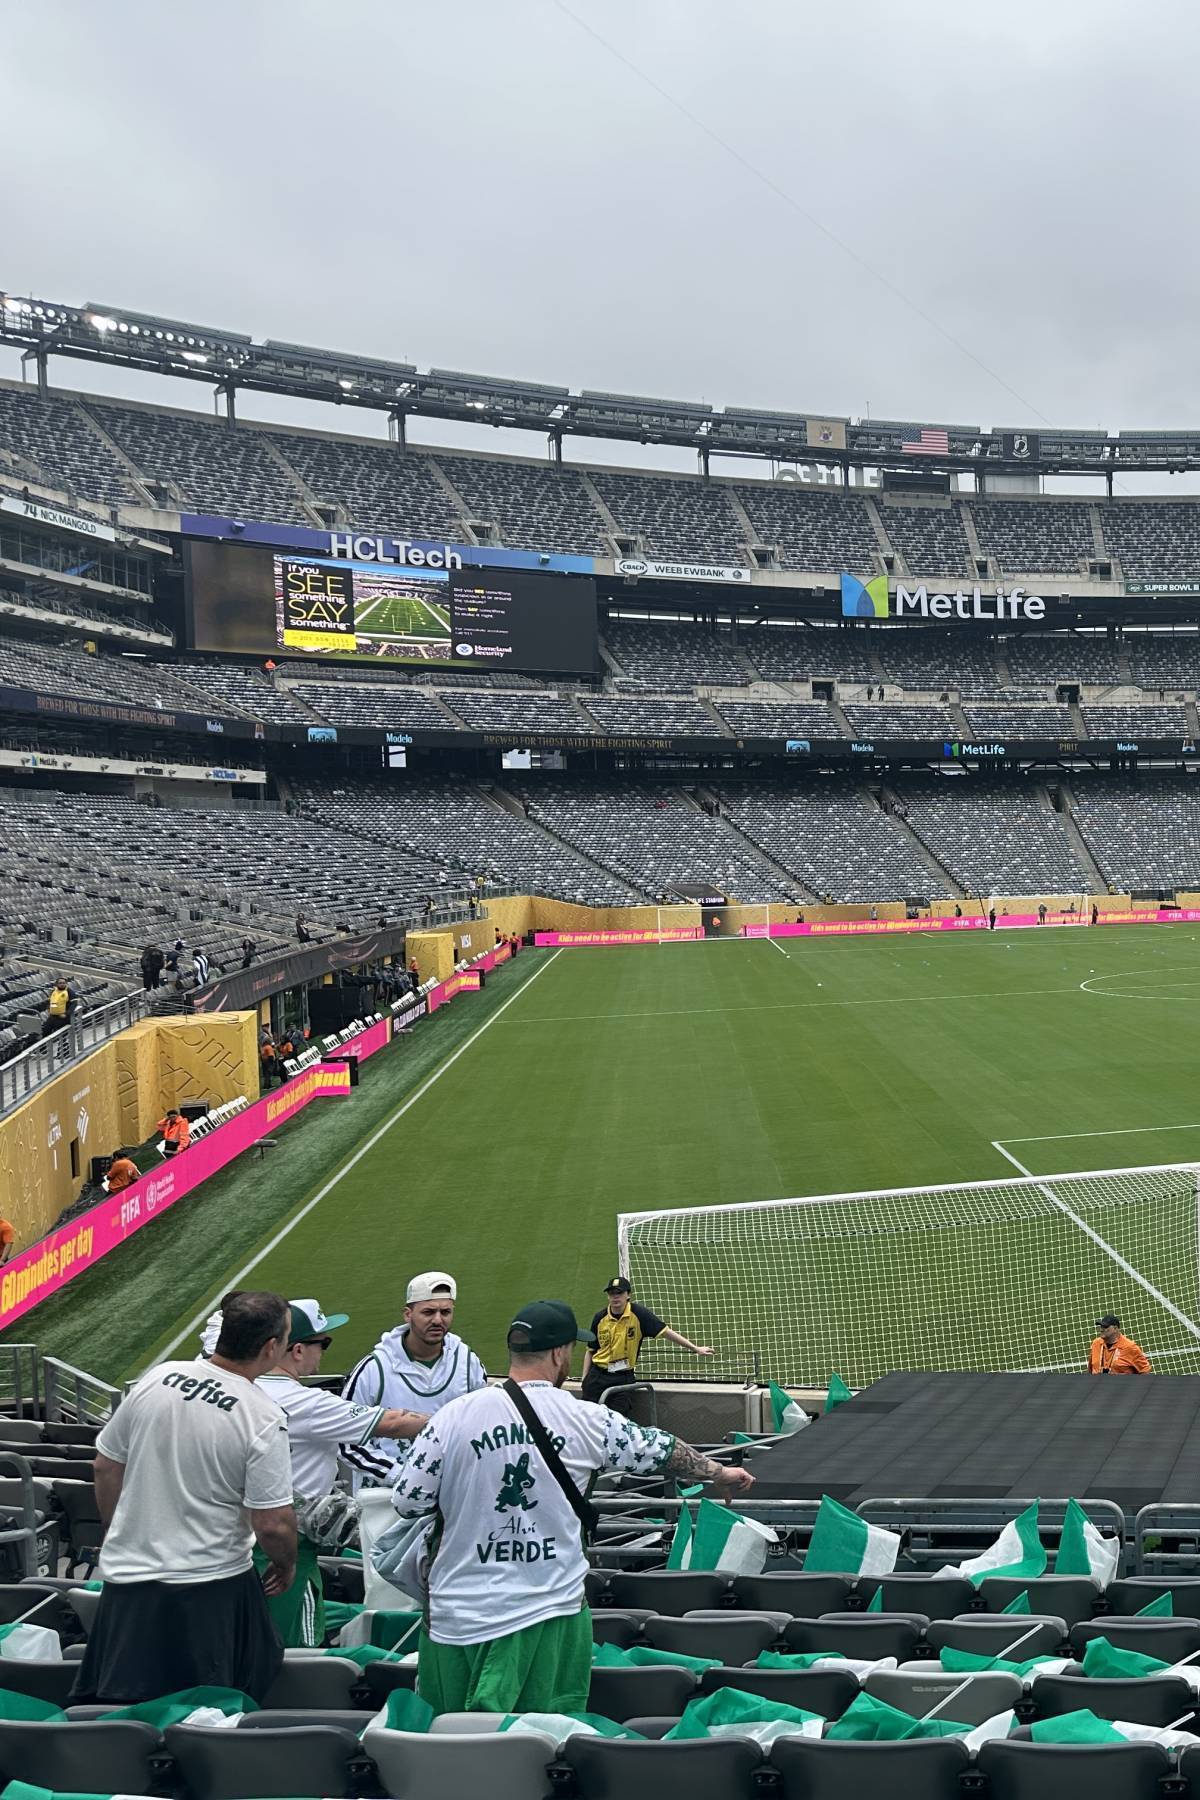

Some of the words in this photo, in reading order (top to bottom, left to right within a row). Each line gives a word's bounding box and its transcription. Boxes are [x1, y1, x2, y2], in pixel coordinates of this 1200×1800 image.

[22, 503, 38, 518] 74
[40, 510, 59, 522] NICK
[59, 514, 97, 534] MANGOLD
[330, 534, 462, 569] HCLTech
[298, 567, 319, 576] you
[654, 565, 683, 575] WEEB
[684, 567, 725, 578] EWBANK
[287, 573, 345, 597] SEE
[288, 593, 345, 605] something
[288, 599, 348, 622] SAY
[896, 584, 1046, 620] MetLife
[474, 645, 512, 653] Homeland
[386, 732, 413, 744] Modelo
[851, 743, 875, 752] Modelo
[962, 744, 1006, 755] MetLife
[1116, 743, 1139, 751] Modelo
[559, 934, 574, 943] Kids
[574, 934, 592, 942] need
[610, 932, 632, 941] active
[48, 1124, 62, 1148] ULTRA
[120, 1194, 140, 1227] FIFA
[1, 1268, 17, 1313] 60
[16, 1250, 59, 1303] minutes
[59, 1243, 76, 1277] per
[77, 1225, 94, 1259] day
[162, 1372, 239, 1412] crefisa
[477, 1537, 557, 1564] VERDE
